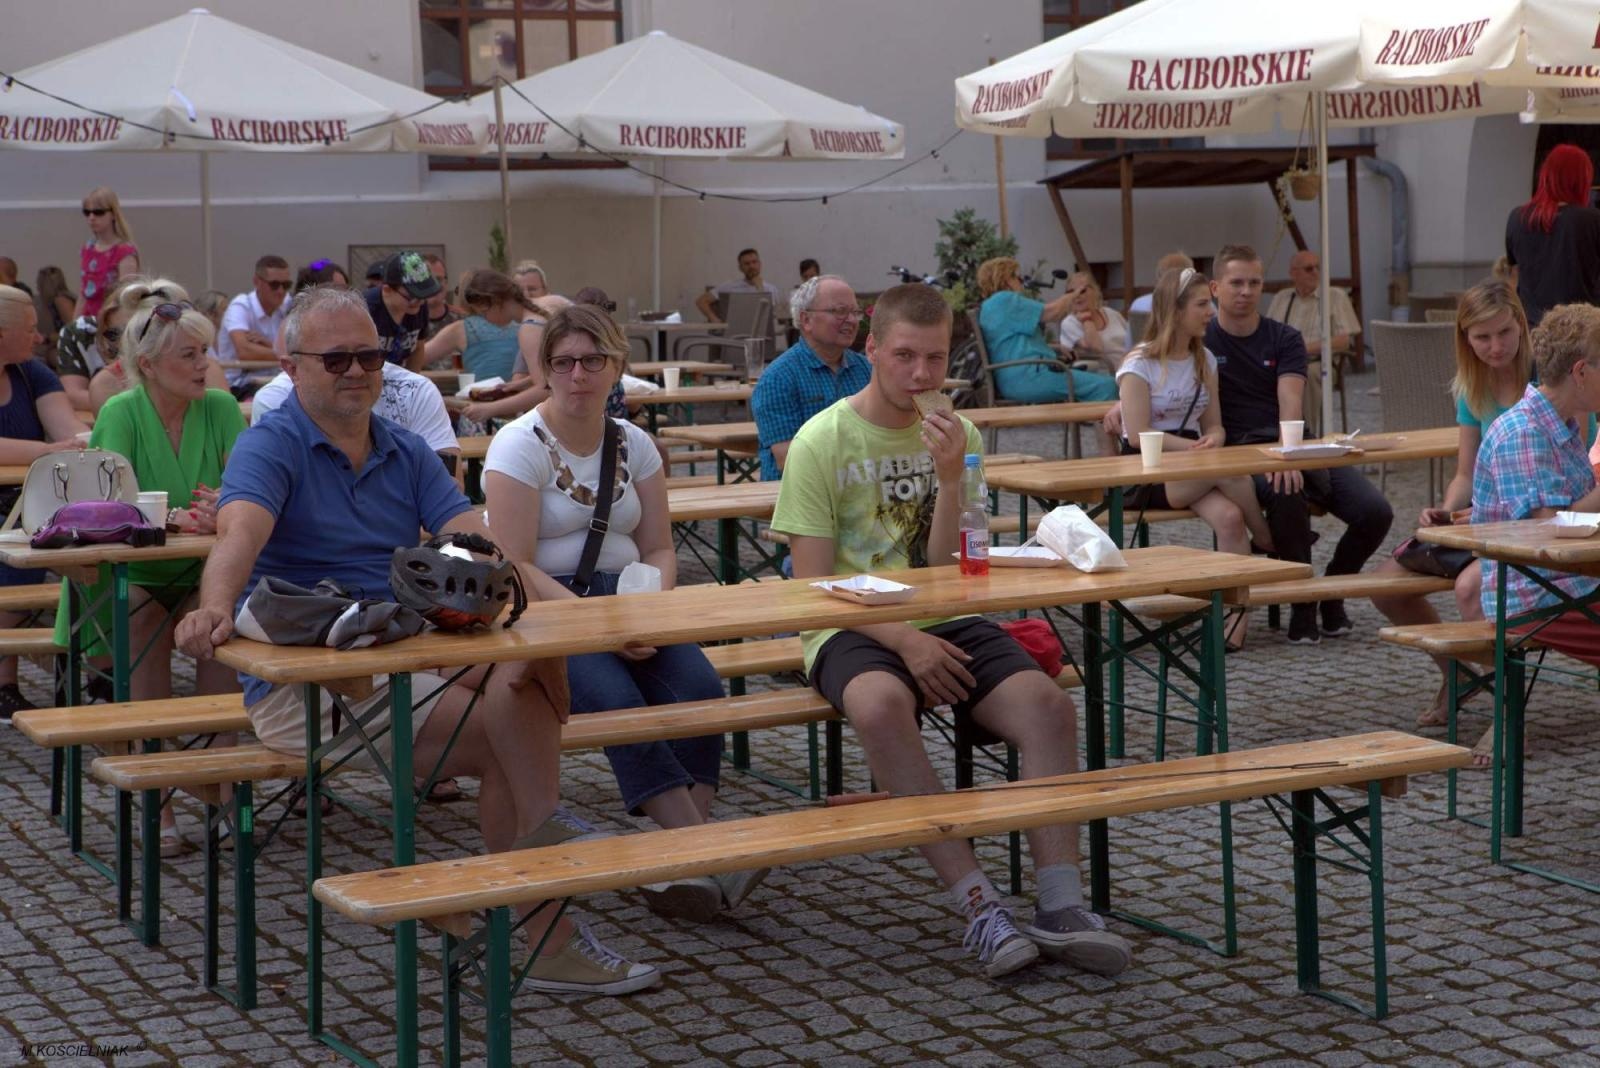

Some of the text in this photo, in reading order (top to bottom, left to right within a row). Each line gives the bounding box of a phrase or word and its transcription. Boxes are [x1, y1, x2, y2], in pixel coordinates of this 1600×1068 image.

[1375, 18, 1490, 66] RACIBORSKIE
[1127, 48, 1314, 92] RACIBORSKIE
[971, 69, 1053, 115] RACIBORSKIE
[0, 115, 121, 142] RACIBORSKIE
[211, 118, 349, 144] RACIBORSKIE
[619, 124, 746, 150] RACIBORSKIE
[809, 128, 885, 153] RACIBORSKIE
